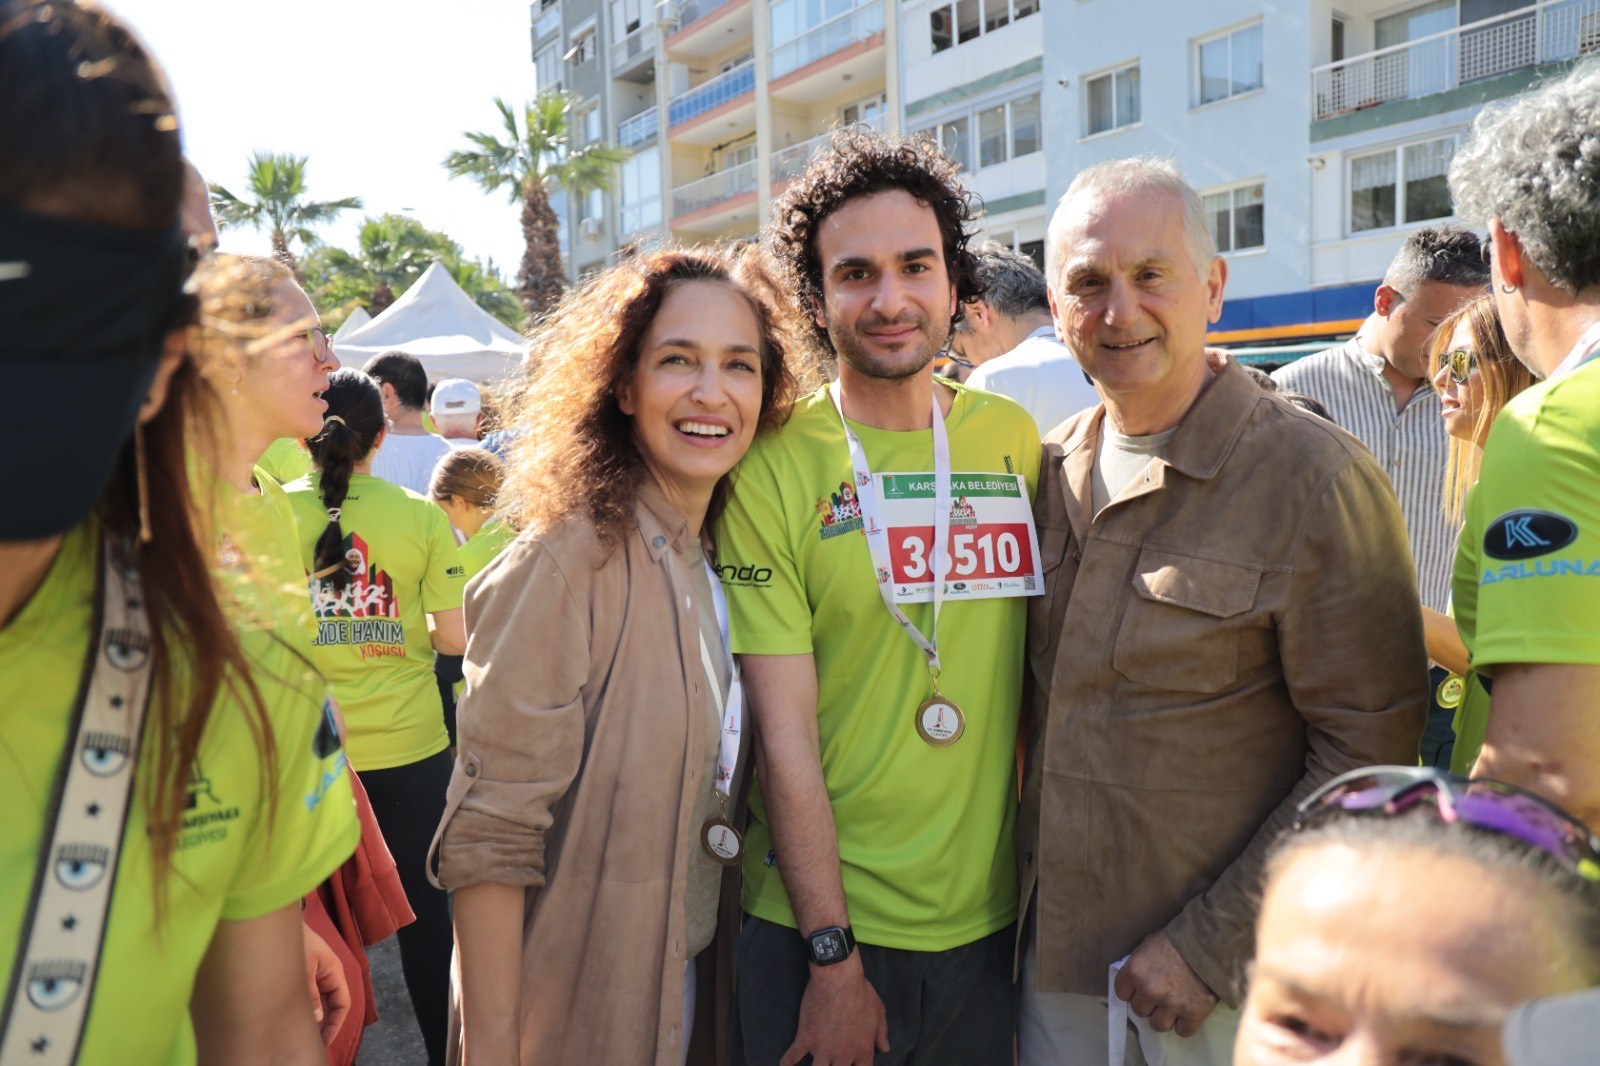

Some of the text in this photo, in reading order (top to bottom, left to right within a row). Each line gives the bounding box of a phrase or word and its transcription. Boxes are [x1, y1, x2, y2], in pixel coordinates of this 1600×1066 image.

[968, 479, 1018, 492] BELEDİYESİ
[350, 619, 405, 645] HANIM
[359, 642, 407, 660] KOŞUSU
